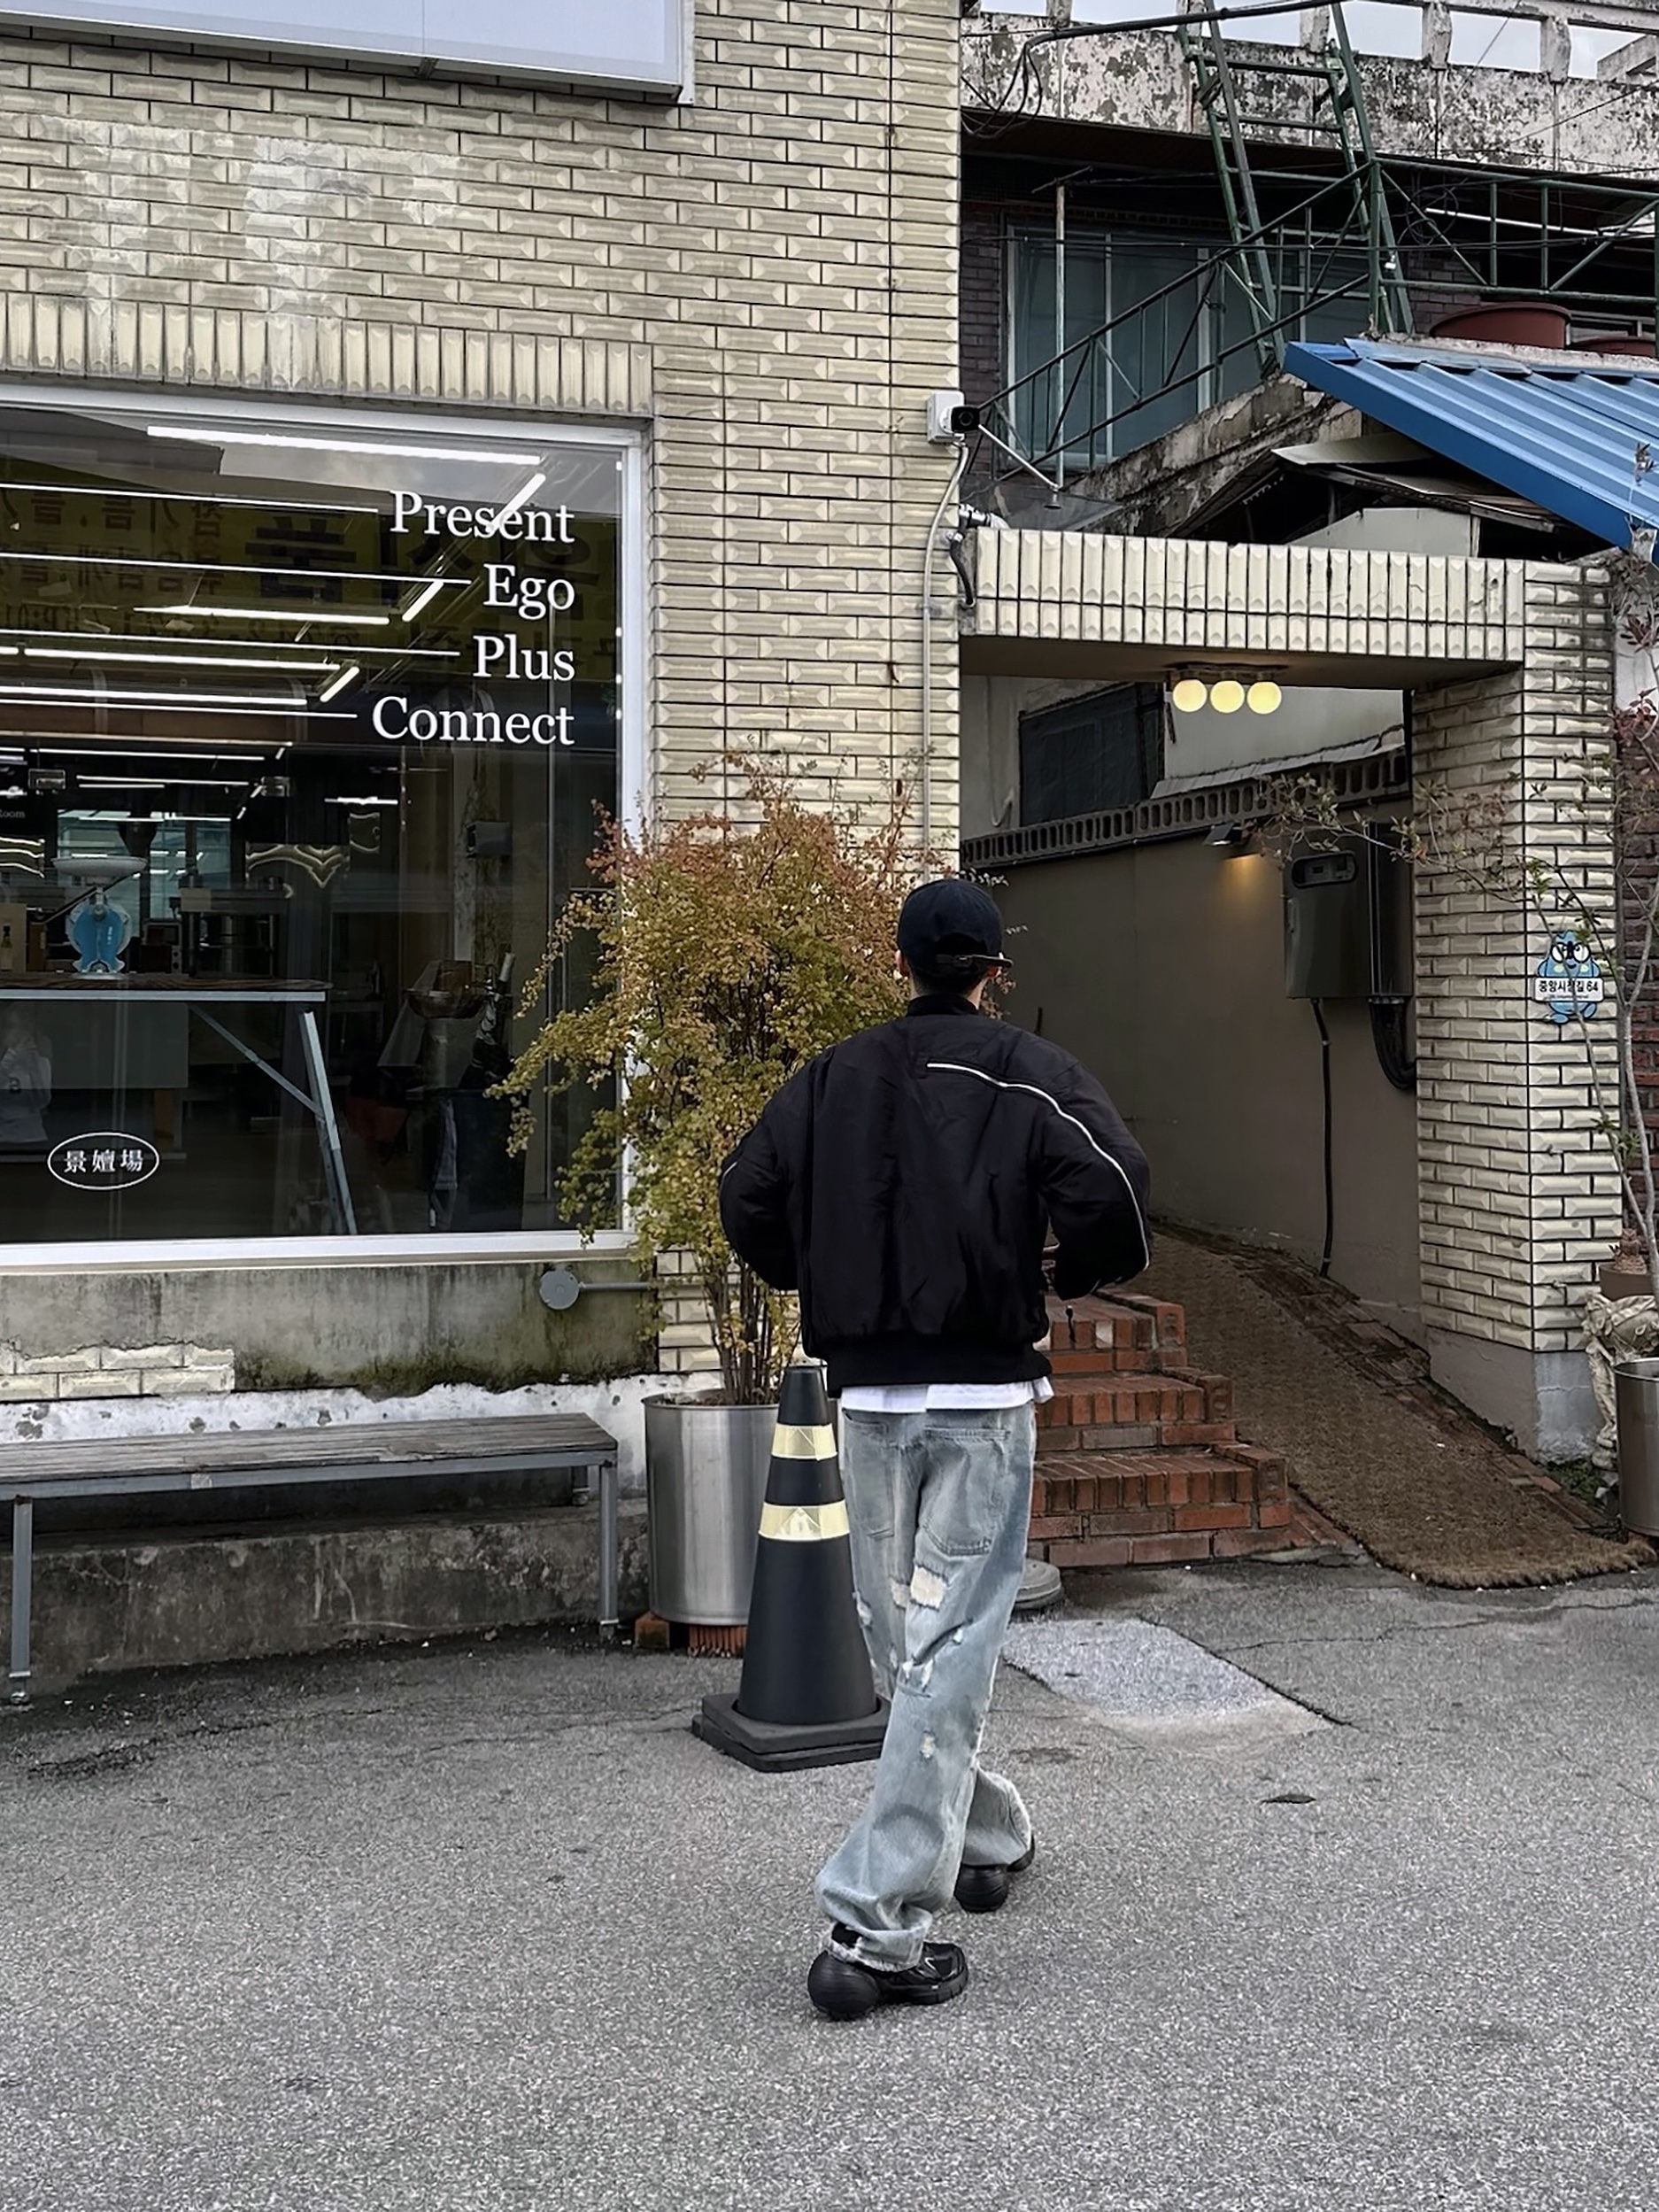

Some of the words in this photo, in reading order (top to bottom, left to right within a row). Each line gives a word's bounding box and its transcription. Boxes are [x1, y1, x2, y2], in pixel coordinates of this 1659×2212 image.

[390, 490, 575, 543] Present
[483, 563, 575, 620] Ego
[473, 634, 575, 681] Plus
[372, 696, 575, 745] Connect
[1586, 980, 1598, 992] 64
